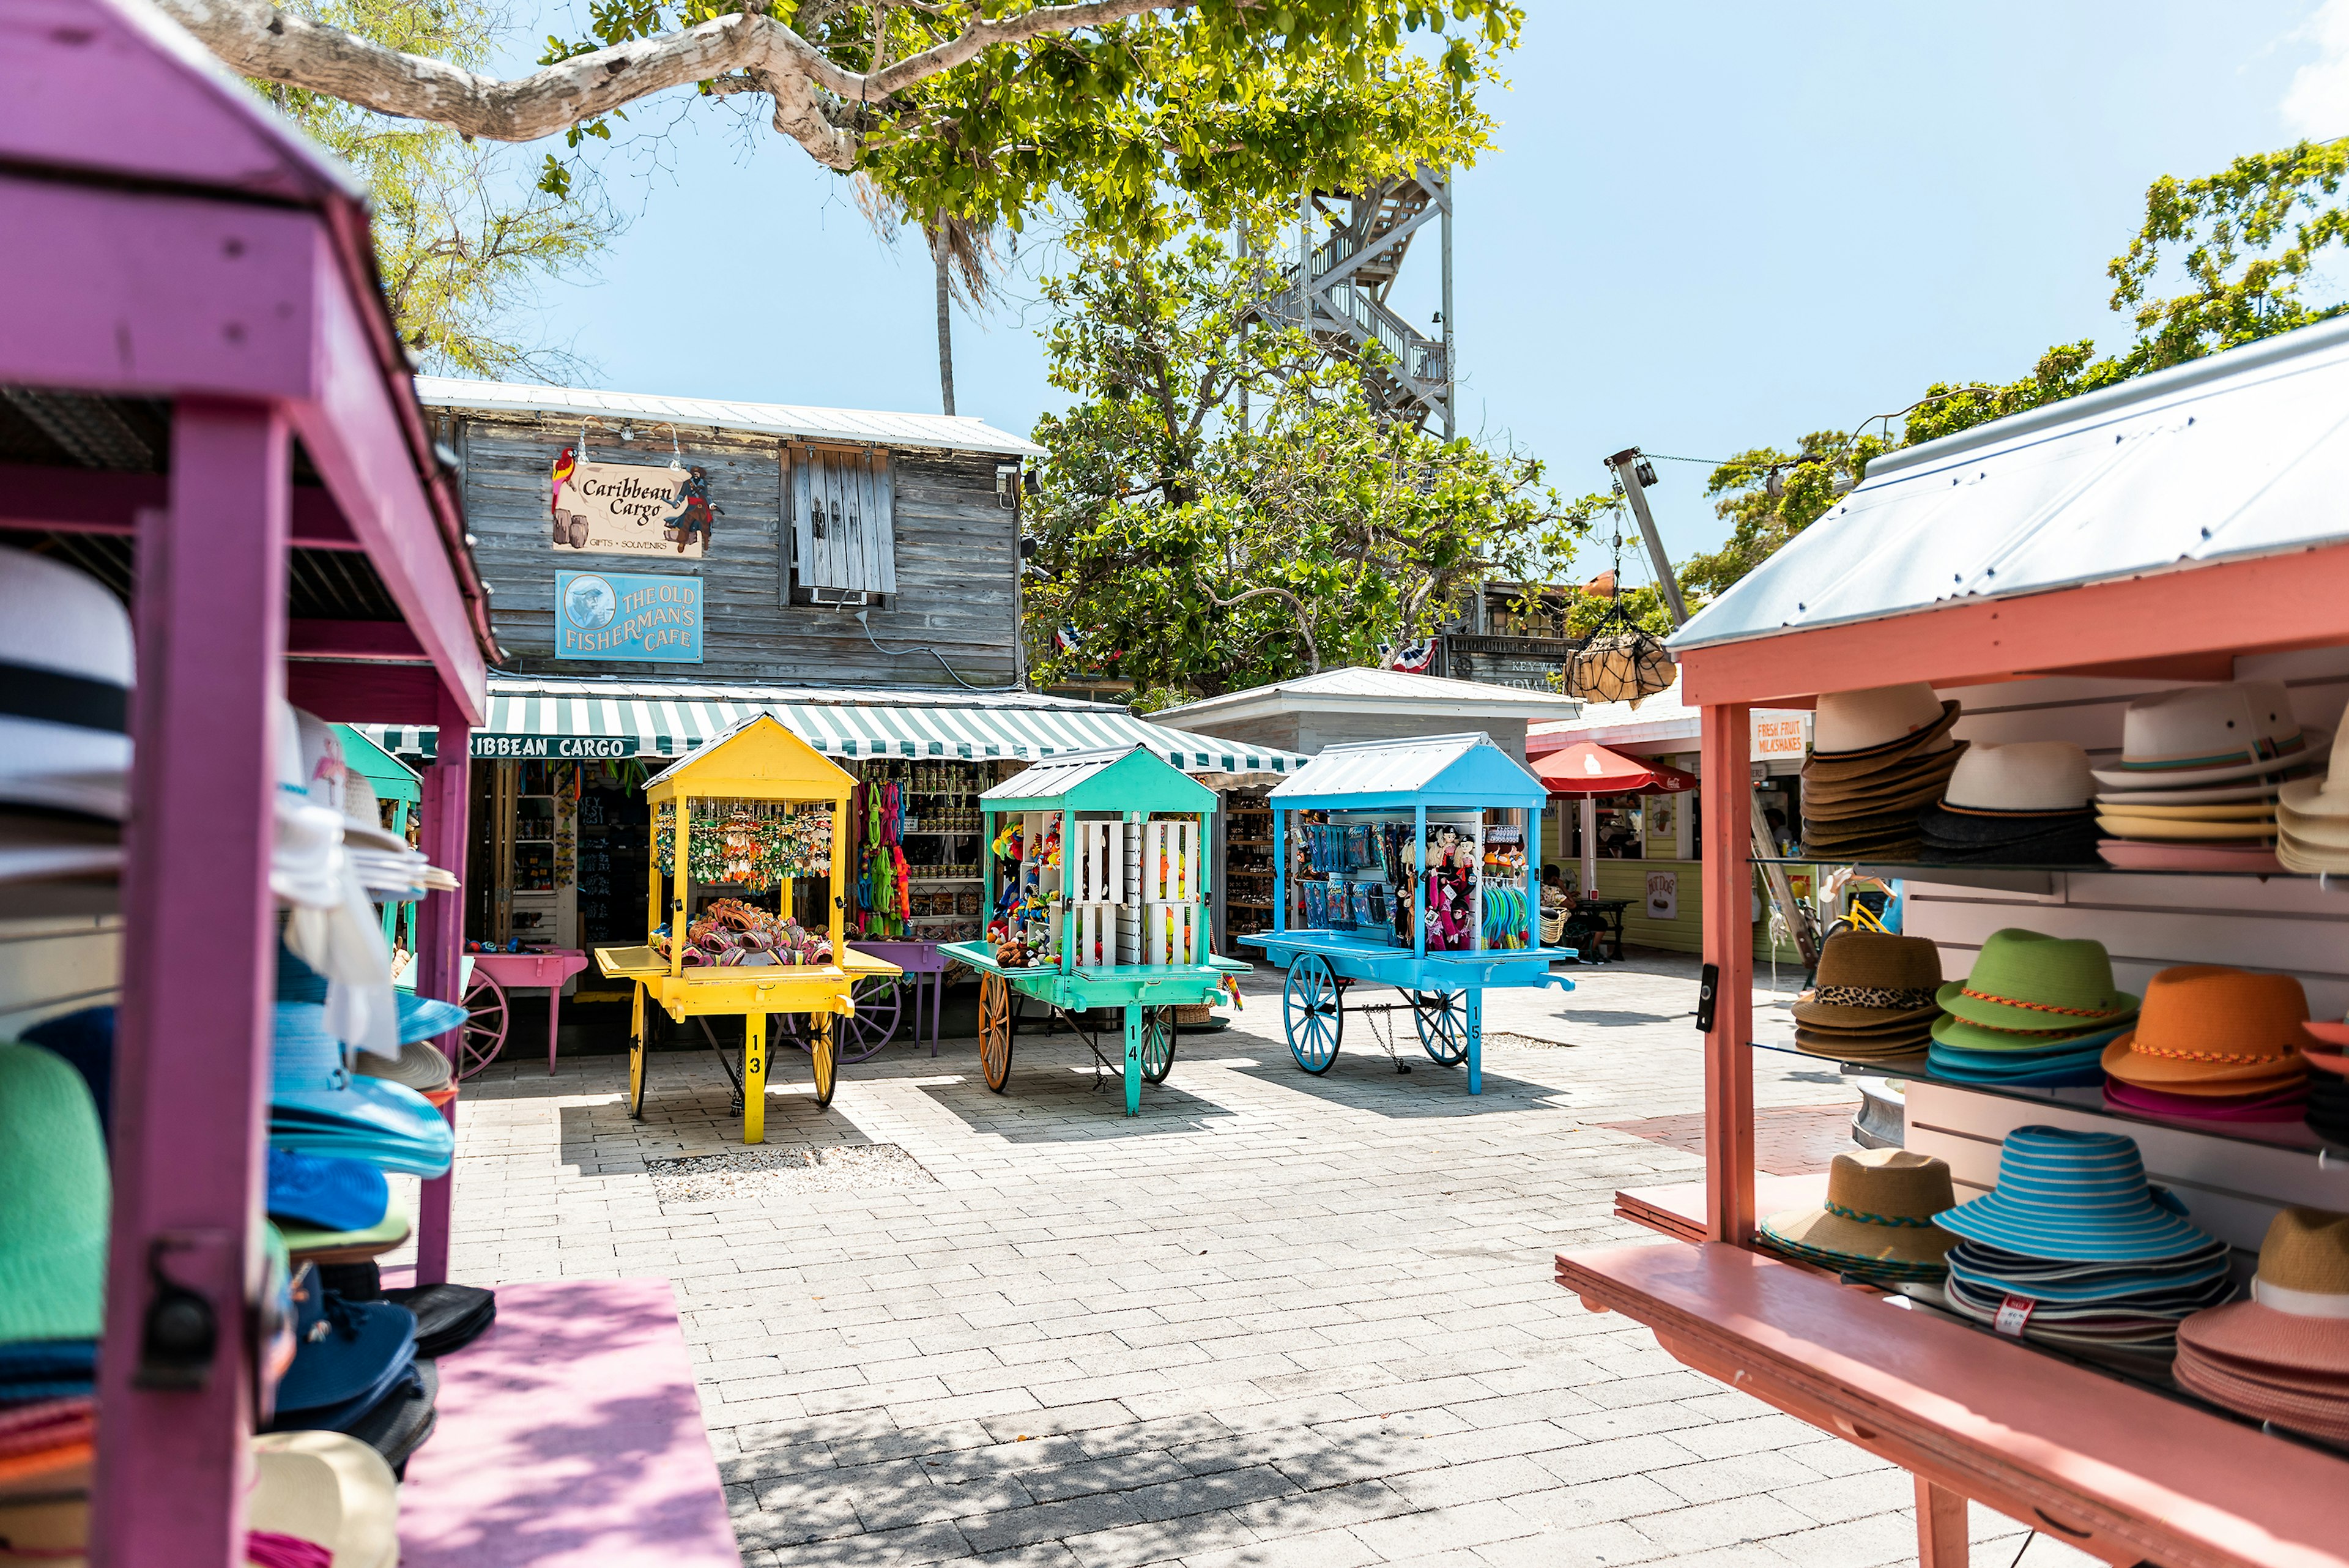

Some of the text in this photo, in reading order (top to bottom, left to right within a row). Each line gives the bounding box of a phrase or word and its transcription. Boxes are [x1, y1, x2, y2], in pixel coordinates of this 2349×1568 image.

[583, 477, 672, 500] Caribbean
[610, 498, 662, 526] Cargo
[590, 538, 667, 549] GIFTS SOUVENIRS
[623, 585, 695, 614] THE OLD
[565, 604, 696, 652] FISHERMAN'S
[644, 628, 692, 652] CAFE
[1512, 661, 1564, 672] KEY WES
[1757, 721, 1800, 738] FRESH FRUIT
[435, 737, 624, 757] RIBBEAN CARGO
[1759, 737, 1802, 754] MILKSHAKES
